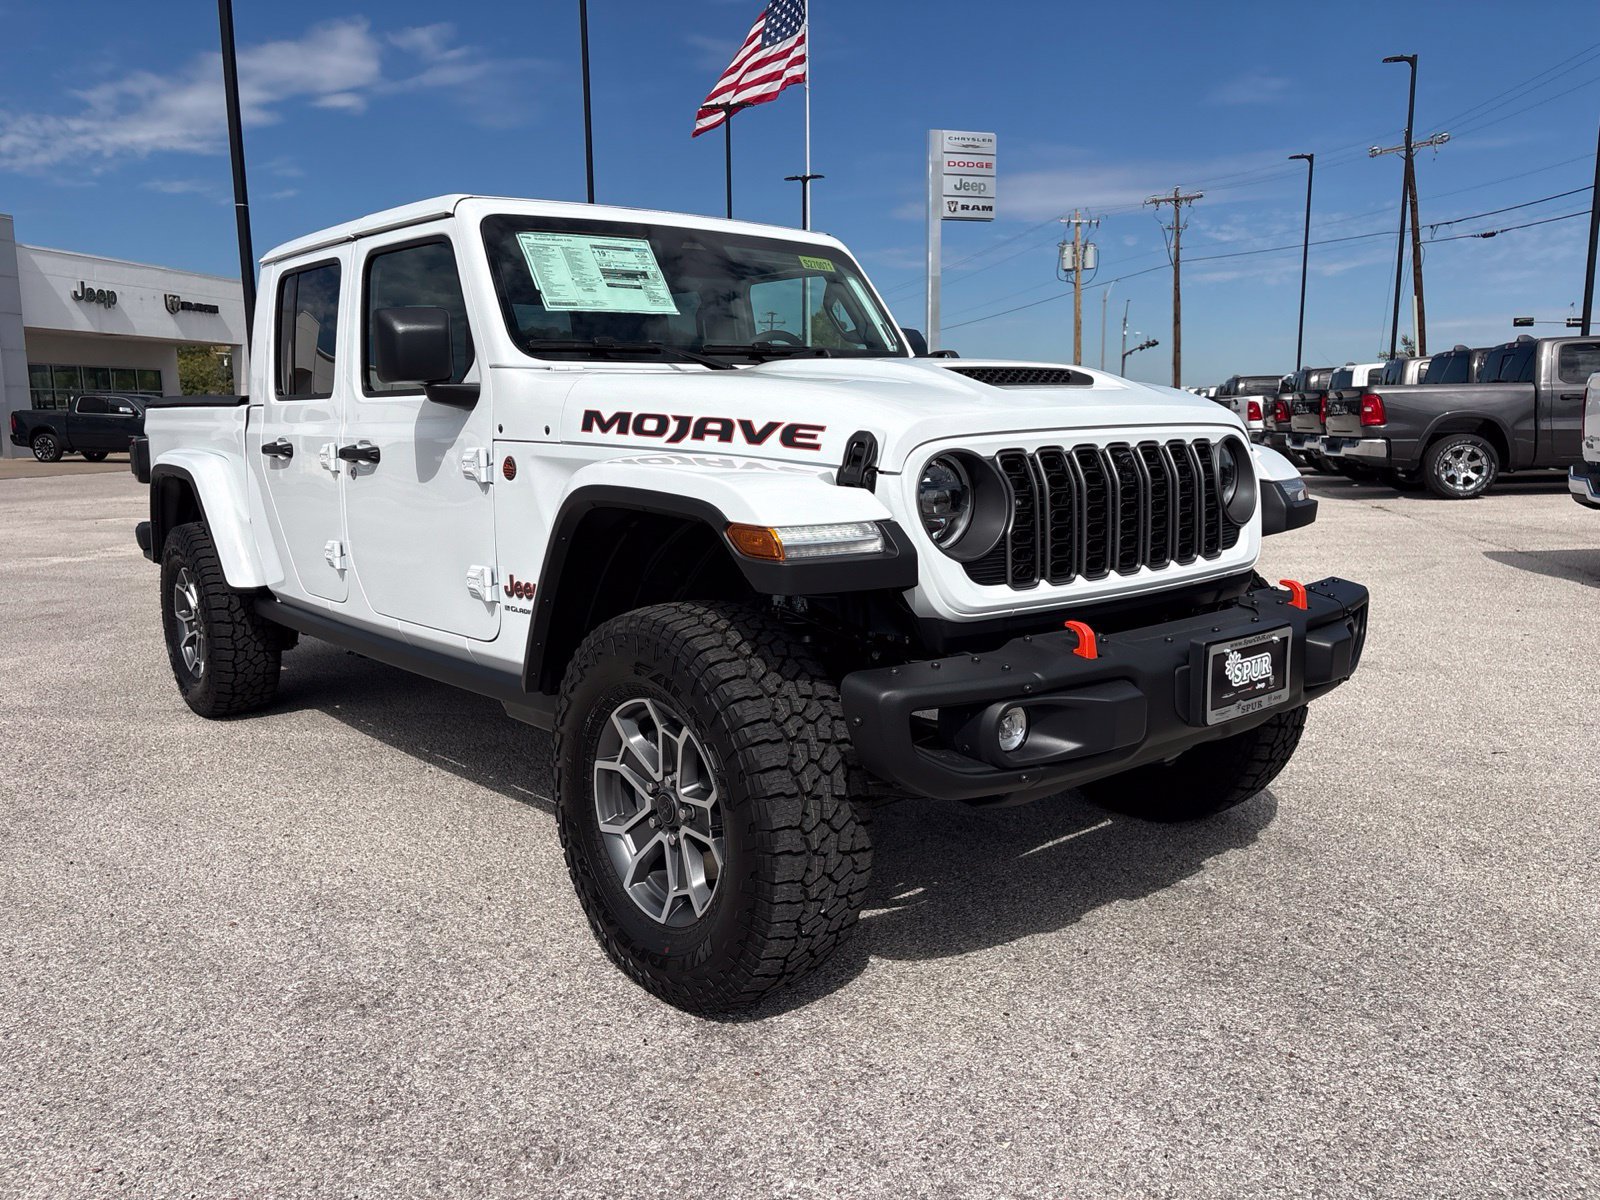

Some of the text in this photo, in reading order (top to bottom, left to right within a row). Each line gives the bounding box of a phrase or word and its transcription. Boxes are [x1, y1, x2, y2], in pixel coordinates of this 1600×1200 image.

[947, 161, 993, 169] DODGE
[954, 178, 986, 194] Jeep
[961, 204, 993, 212] RAM
[71, 280, 117, 309] Jeep
[581, 409, 826, 450] MOJAVE
[511, 606, 531, 614] GLADI
[1234, 656, 1271, 684] SPUR
[1241, 700, 1263, 713] SPUR
